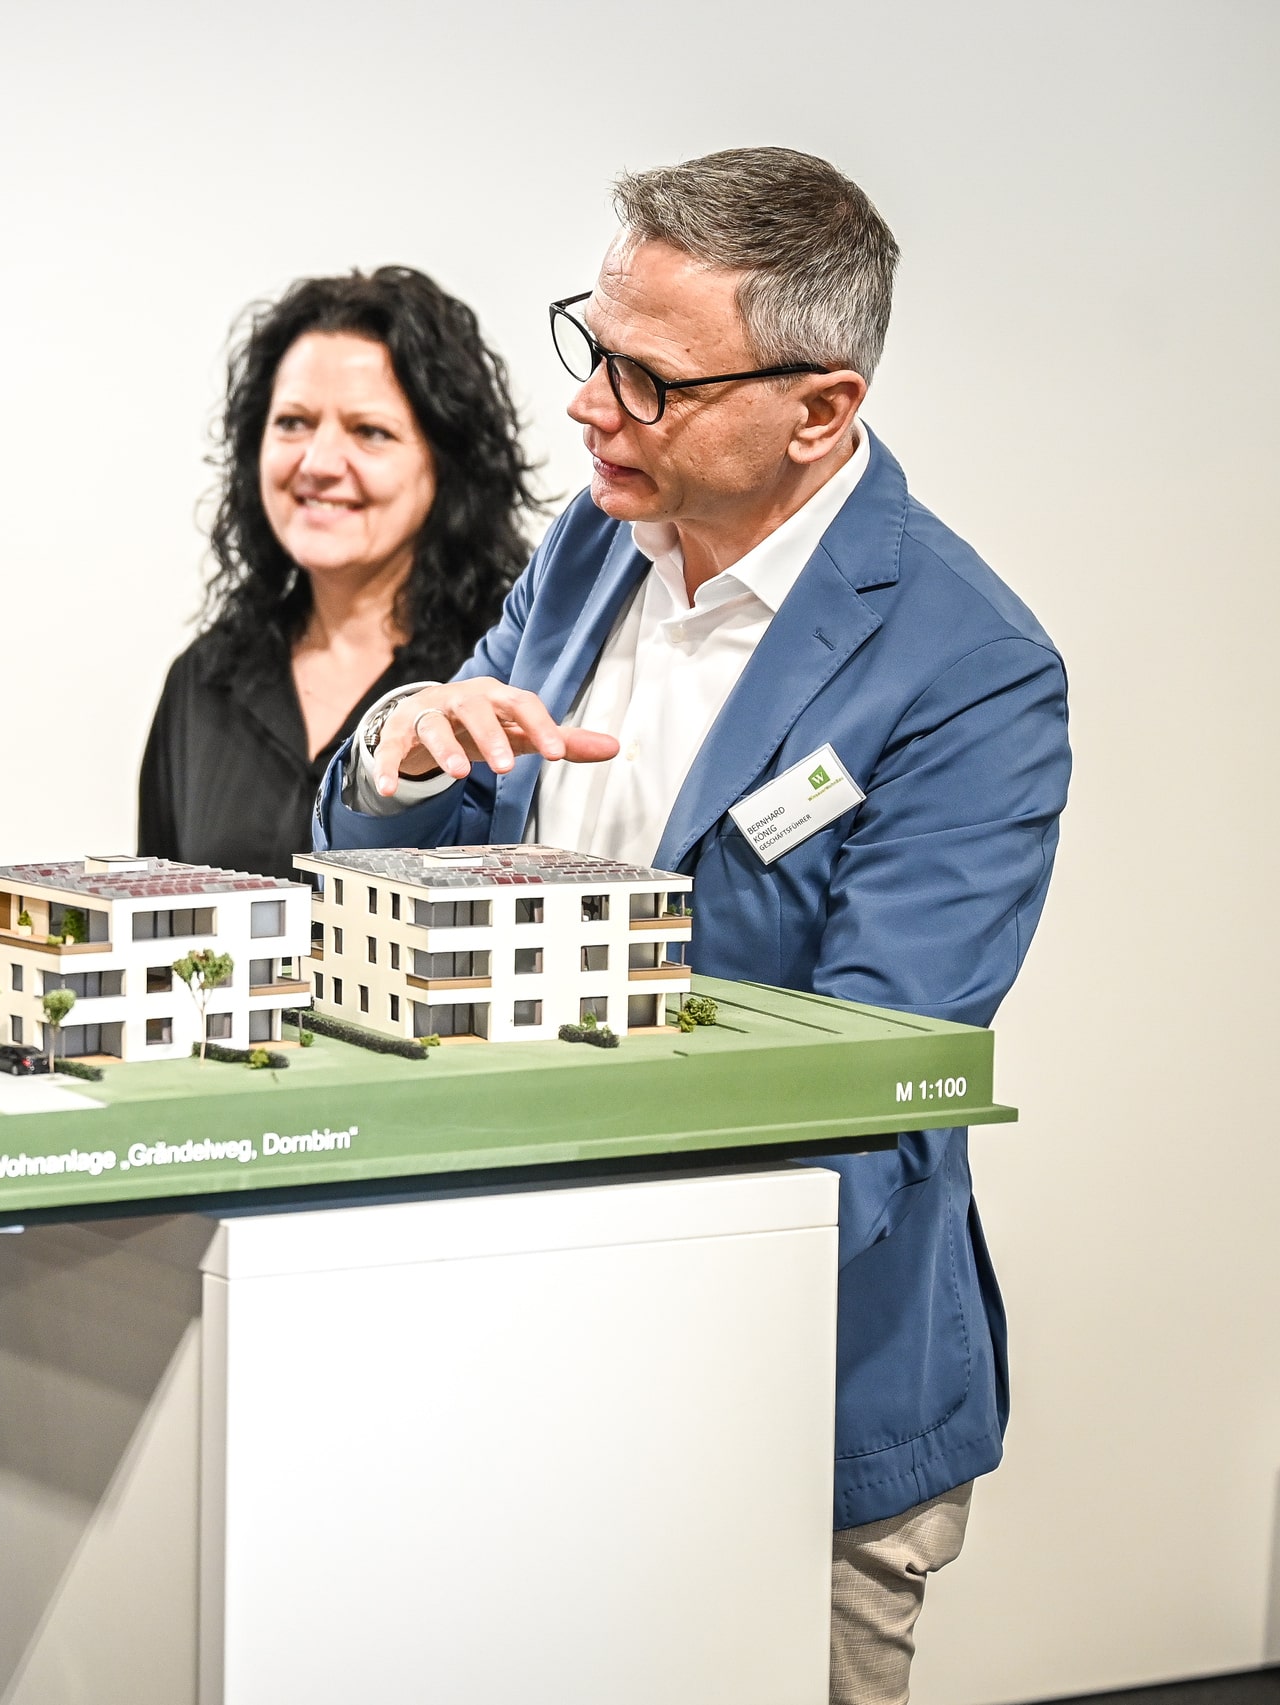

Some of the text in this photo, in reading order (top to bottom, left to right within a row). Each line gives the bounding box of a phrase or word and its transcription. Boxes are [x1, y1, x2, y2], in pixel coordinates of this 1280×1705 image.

[746, 806, 786, 835] BERNHARD
[752, 824, 778, 844] KÖNIG
[759, 813, 812, 851] GESCHÄFTSFÜHRER
[896, 1076, 967, 1102] M 1:100
